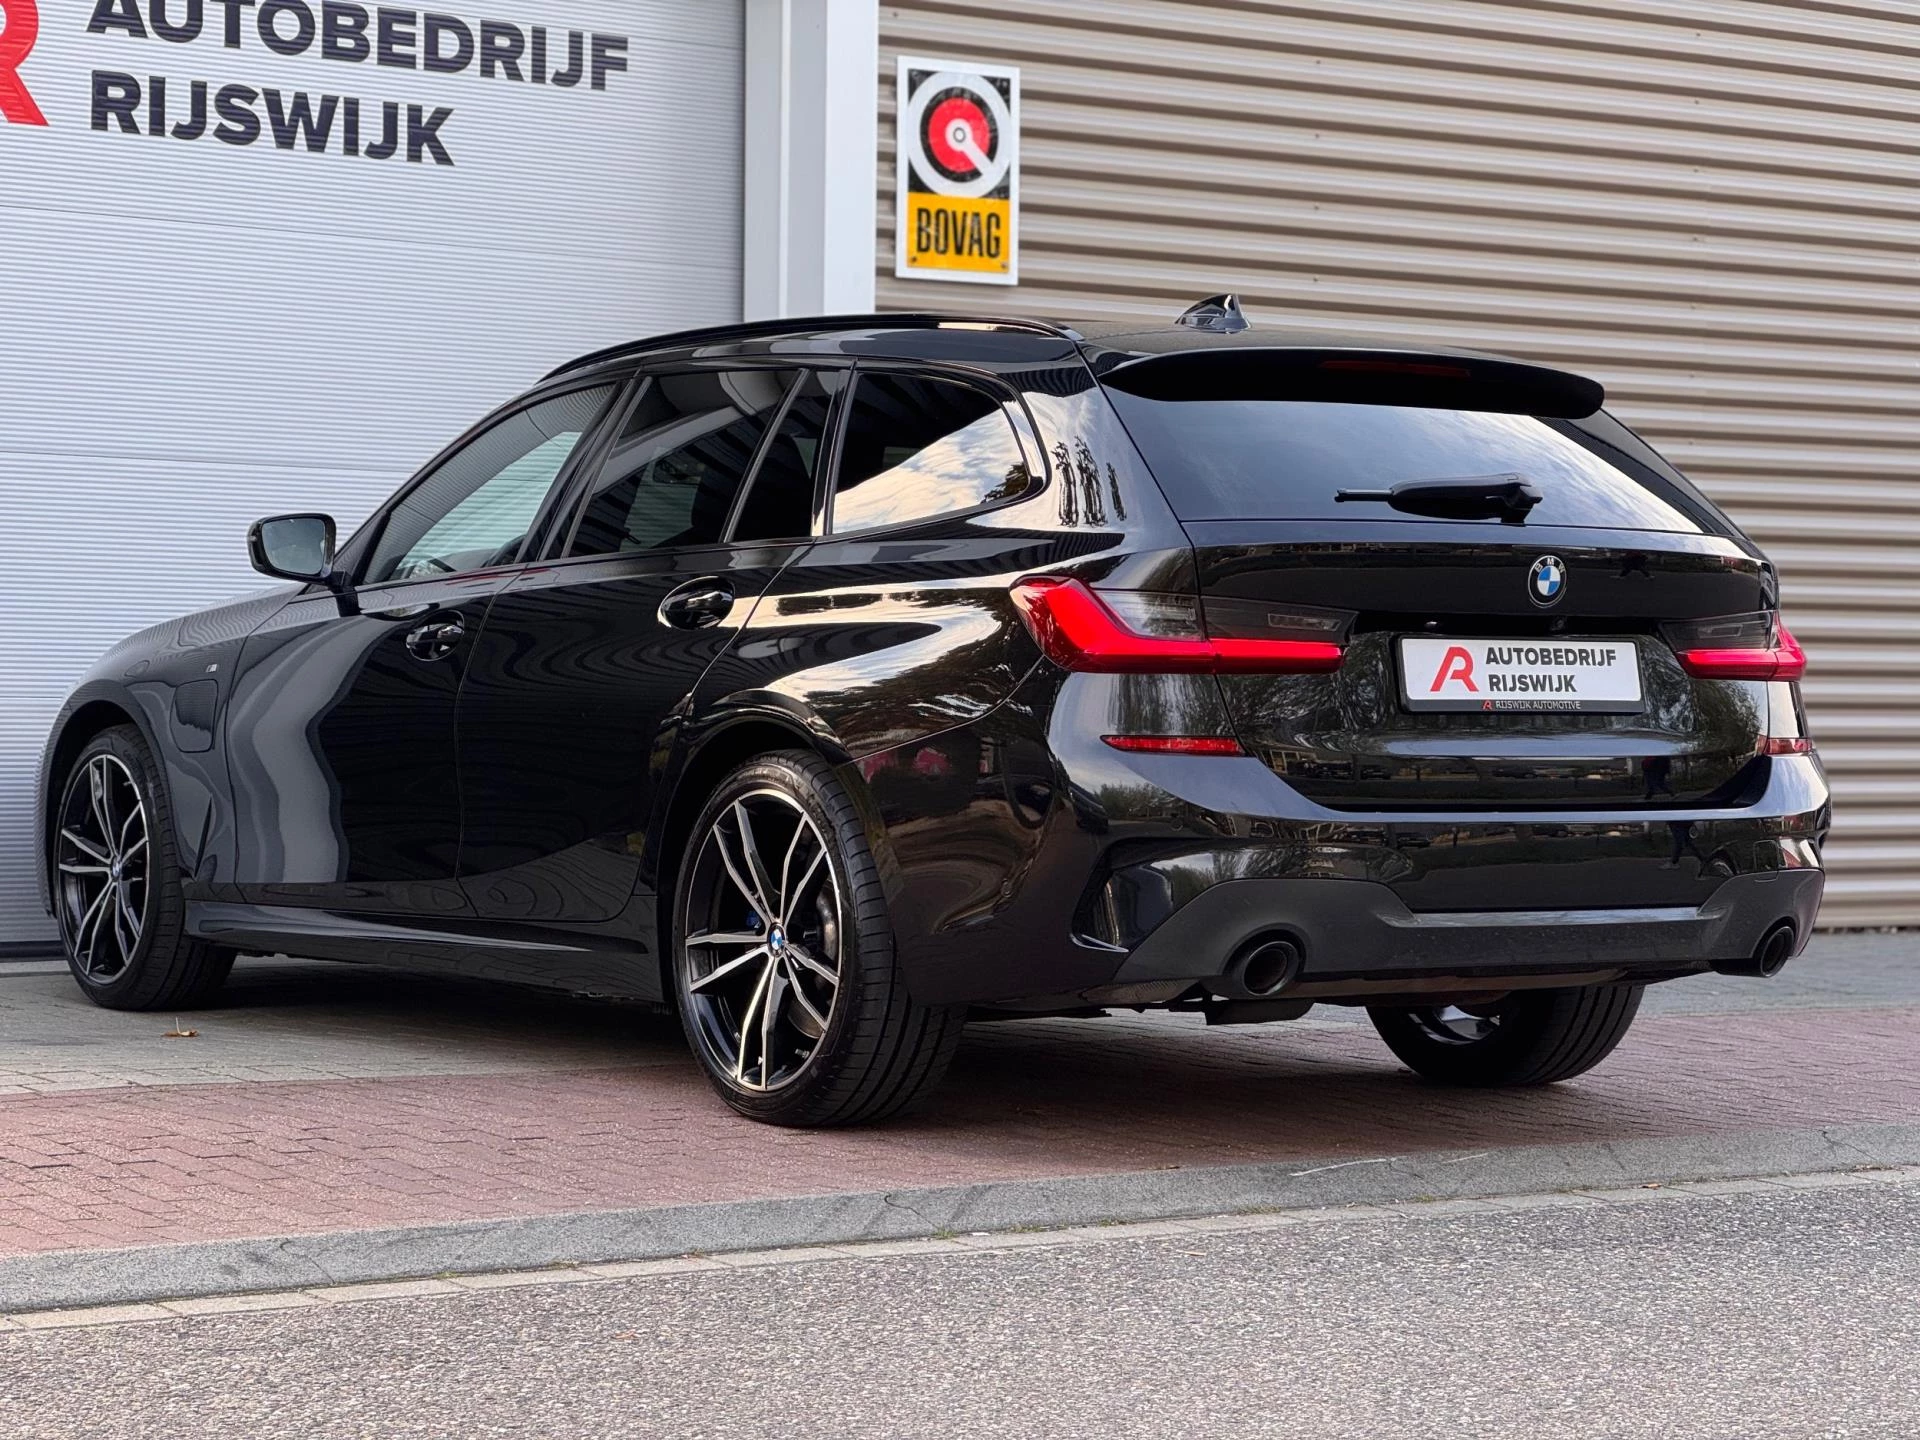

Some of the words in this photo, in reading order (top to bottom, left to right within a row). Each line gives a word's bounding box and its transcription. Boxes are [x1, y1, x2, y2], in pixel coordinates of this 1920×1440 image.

[87, 0, 628, 91] AUTOBEDRIJF
[91, 69, 455, 166] RIJSWIJK
[917, 208, 1001, 258] BOVAG
[1485, 646, 1617, 666] AUTOBEDRIJF
[1488, 674, 1578, 692] RIJSWIJK
[1495, 700, 1532, 709] RIJSWIJK
[1532, 700, 1581, 710] AUTOMOTIVE
